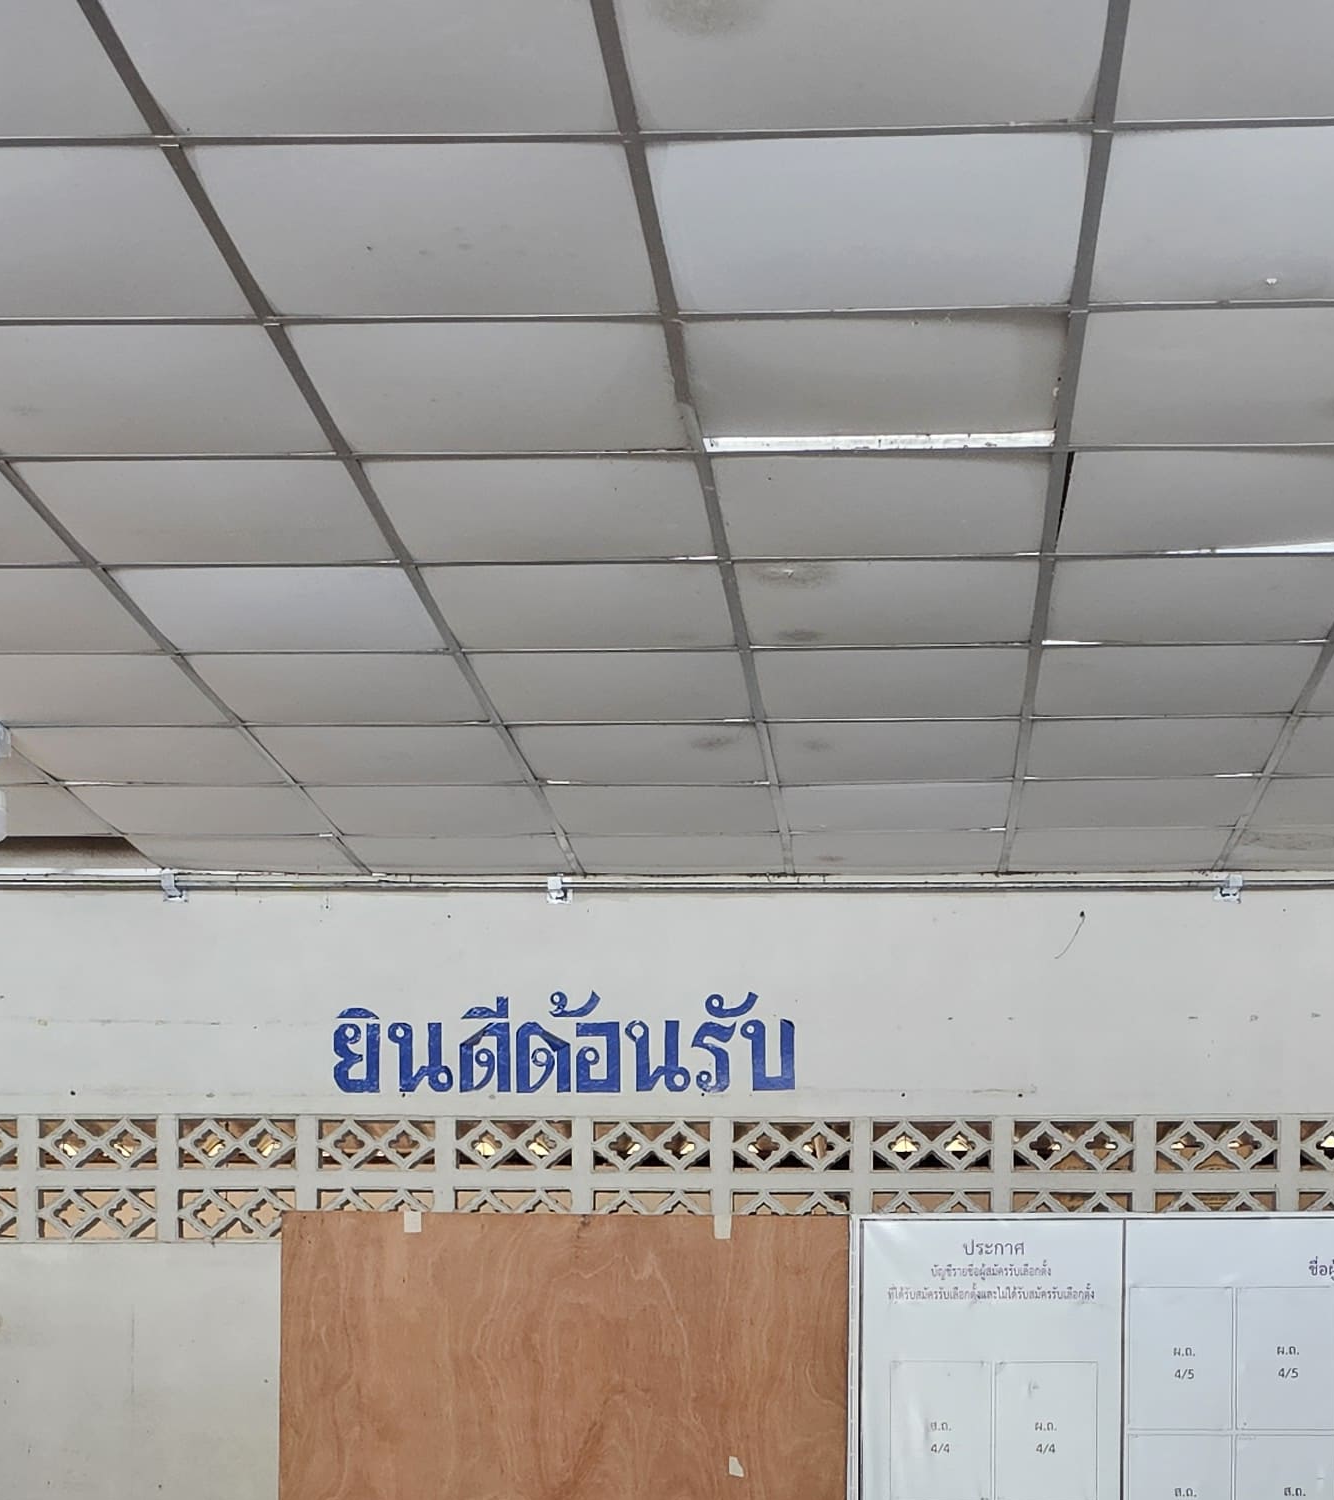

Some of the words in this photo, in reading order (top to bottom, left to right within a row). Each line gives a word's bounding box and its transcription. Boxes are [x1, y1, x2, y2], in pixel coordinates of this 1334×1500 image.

[962, 1239, 1025, 1256] ประกาศ
[1173, 1347, 1196, 1357] ผ.ถ.
[1276, 1345, 1300, 1356] ผ.ถ.
[1174, 1368, 1195, 1380] 4/5
[1277, 1367, 1299, 1379] 4/5
[1034, 1421, 1058, 1432] ผ.ถ.
[930, 1443, 950, 1454] 4/4
[1035, 1443, 1056, 1455] 4/4
[1174, 1487, 1197, 1498] ส.ถ.
[1283, 1486, 1307, 1497] ส.ถ.
